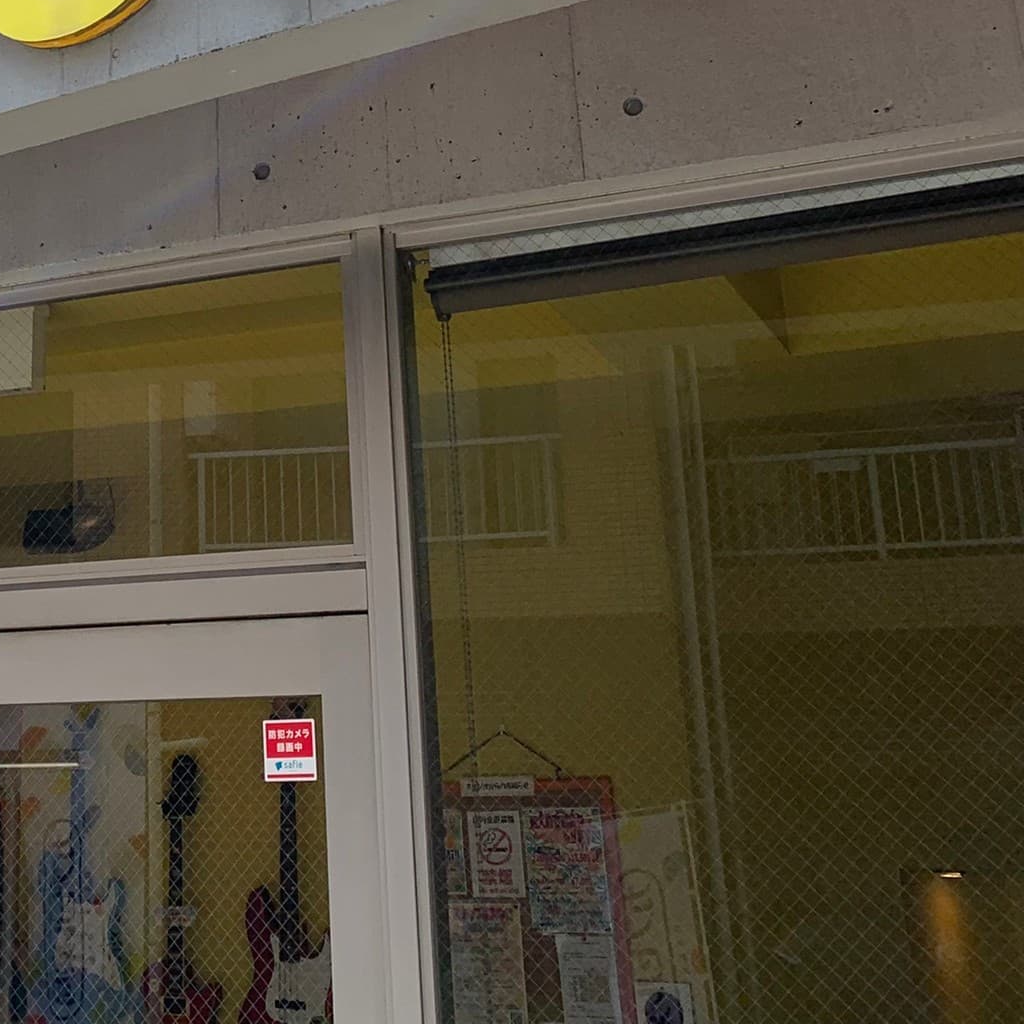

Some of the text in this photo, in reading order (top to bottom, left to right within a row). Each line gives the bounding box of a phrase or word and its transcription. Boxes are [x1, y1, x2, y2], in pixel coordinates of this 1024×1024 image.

[267, 729, 310, 740] 防犯カメラ
